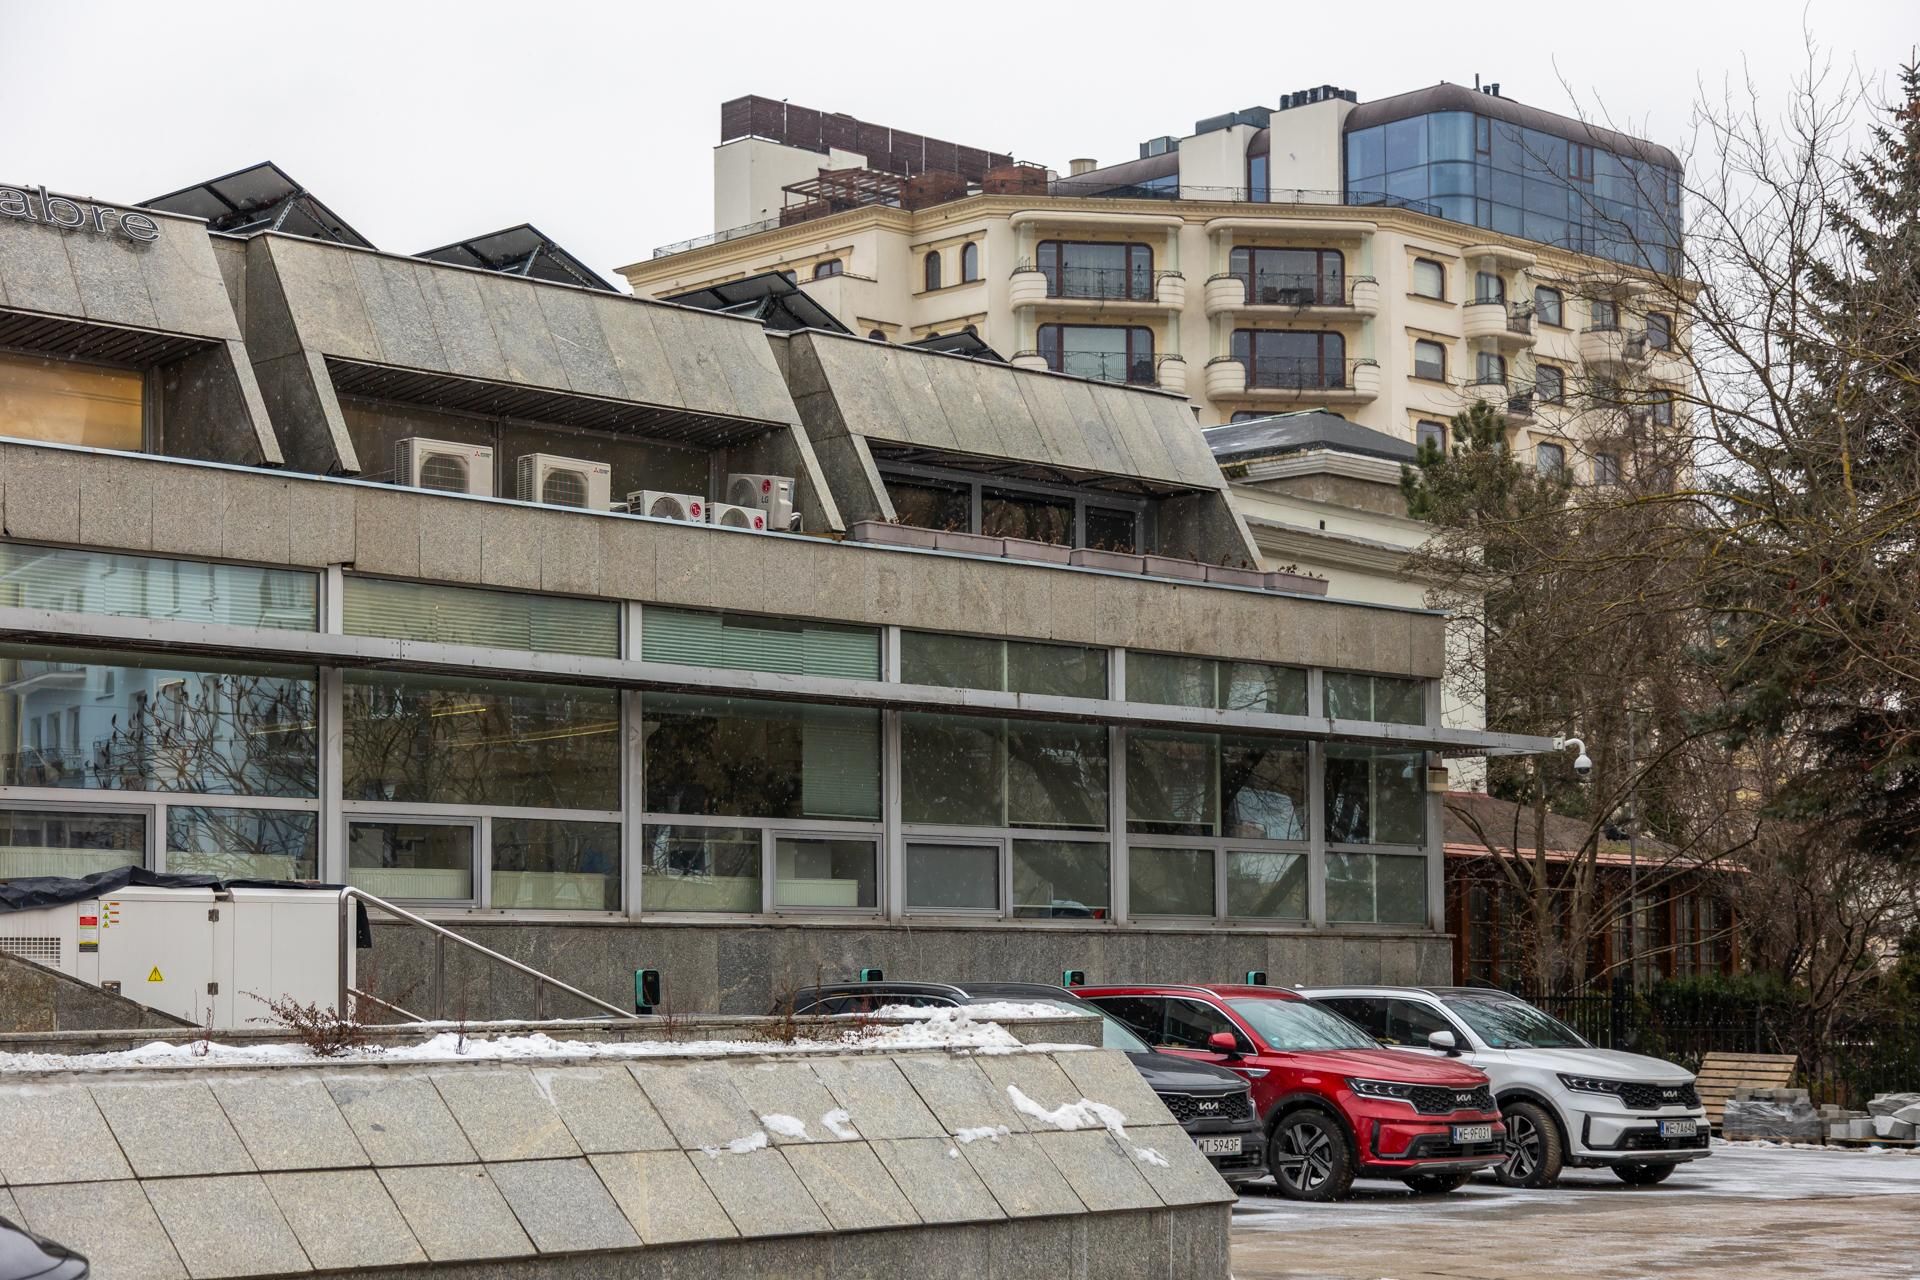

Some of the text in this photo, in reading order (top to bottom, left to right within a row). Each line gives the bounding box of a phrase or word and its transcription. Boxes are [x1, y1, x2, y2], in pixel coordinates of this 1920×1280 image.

[0, 184, 161, 242] abre
[1458, 1127, 1468, 1140] WE
[1665, 1122, 1675, 1134] WE
[1198, 1139, 1239, 1152] WT 5943F
